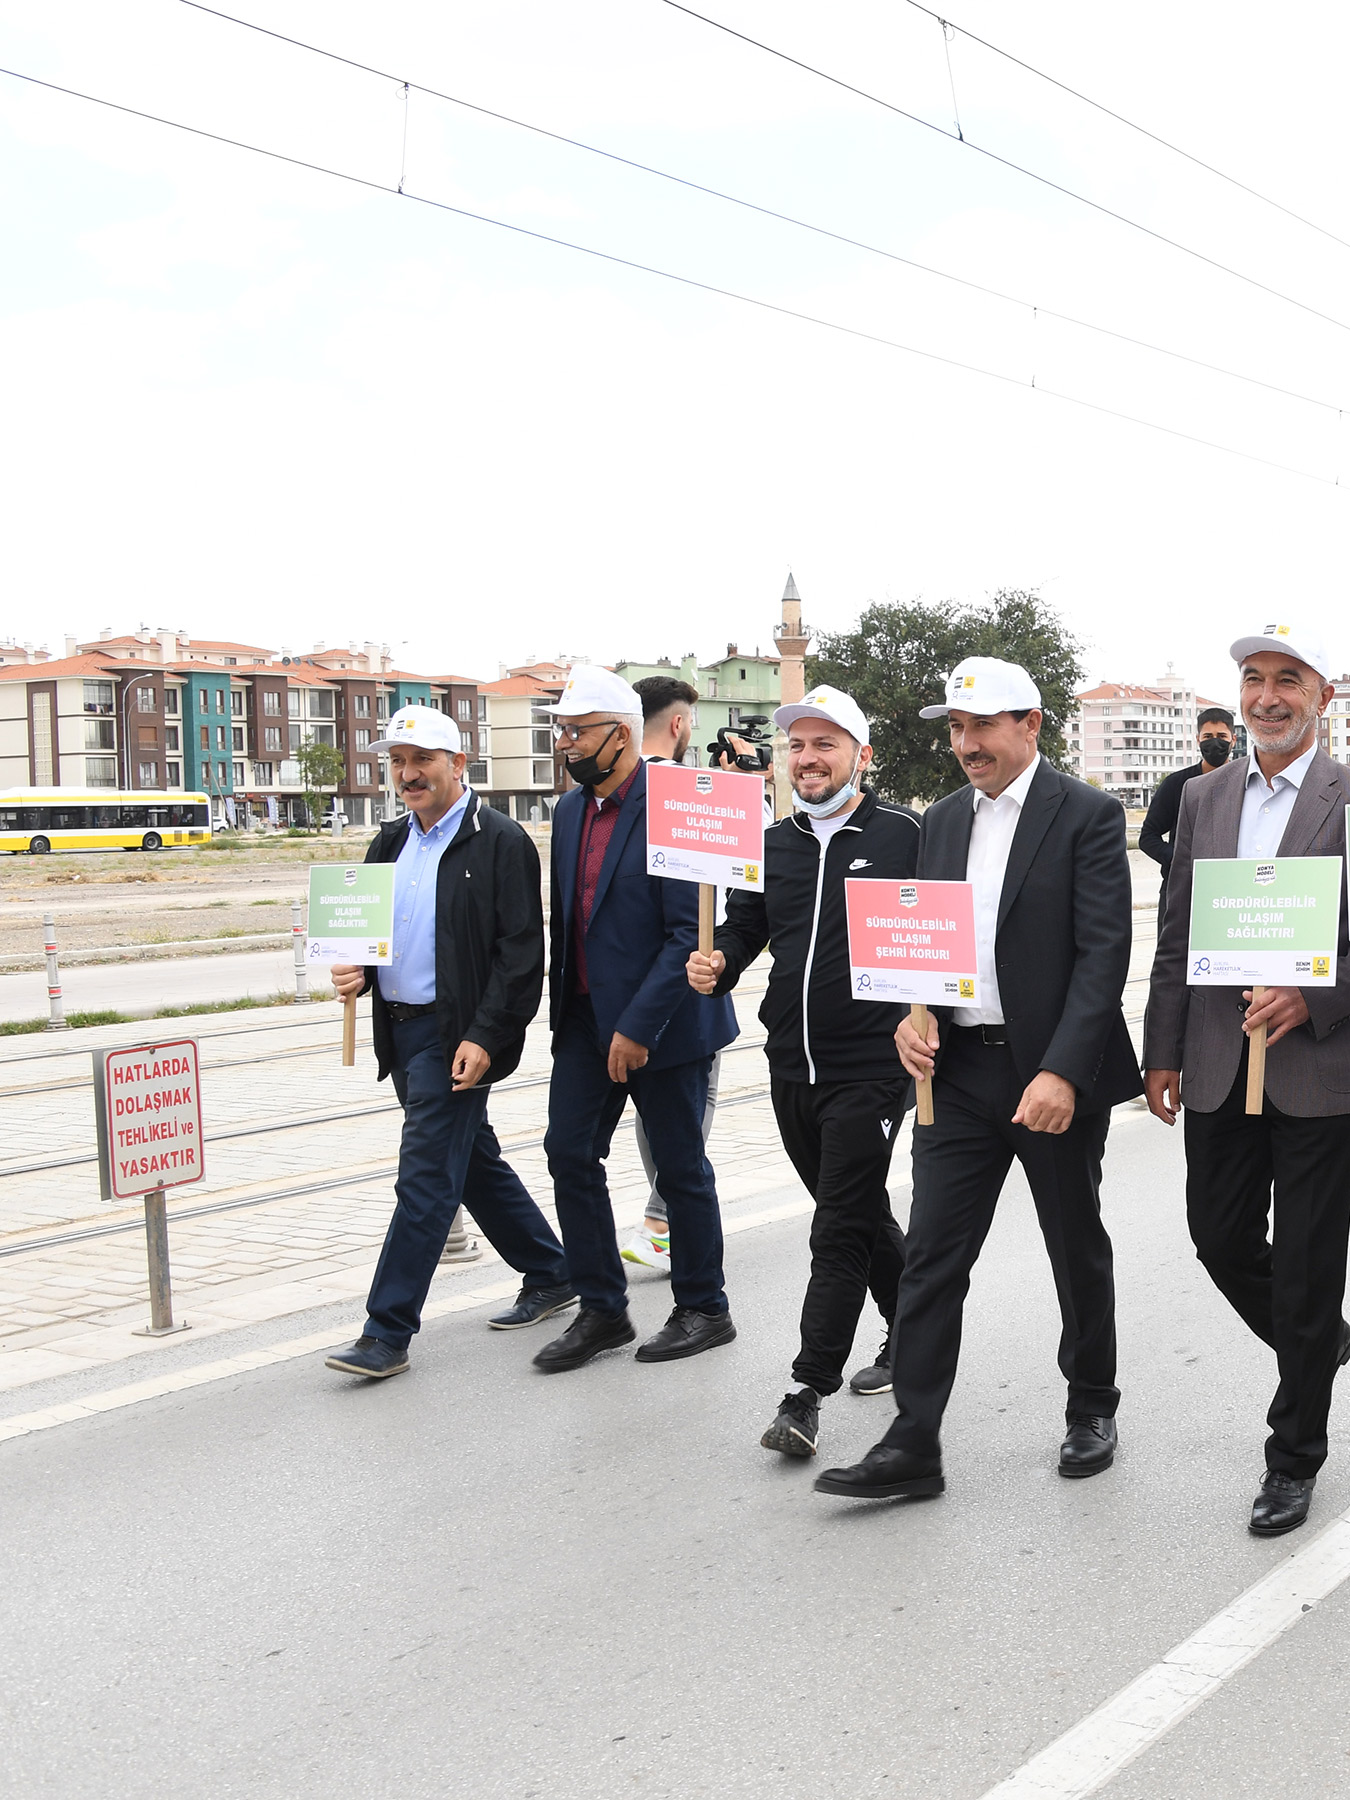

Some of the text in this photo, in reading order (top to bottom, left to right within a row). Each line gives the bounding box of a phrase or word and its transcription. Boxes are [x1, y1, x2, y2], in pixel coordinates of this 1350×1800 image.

[664, 799, 746, 820] SÜRDÜRÜLEBİLİR
[686, 816, 723, 831] ULAŞIM
[671, 828, 738, 846] ŞEHRİ KORUR!
[320, 893, 380, 904] SÜRDÜRÜLEBİLİR
[1212, 895, 1316, 909] SÜRDÜRÜLEBİLİR
[335, 907, 362, 917] ULAŞIM
[1239, 912, 1284, 926] ULAŞIM
[866, 916, 957, 931] SÜRDÜRÜLEBİLİR
[891, 933, 931, 946] ULAŞIM
[1227, 926, 1294, 939] SAĞLIKTIR!
[876, 946, 950, 960] ŞEHRİ KORUR!
[1193, 957, 1210, 975] 20
[114, 1057, 190, 1085] HATLARDA
[116, 1087, 191, 1116] DOLAŞMAK
[118, 1116, 194, 1147] TEHLİKELİ ve
[120, 1148, 195, 1178] YASAKTIR
